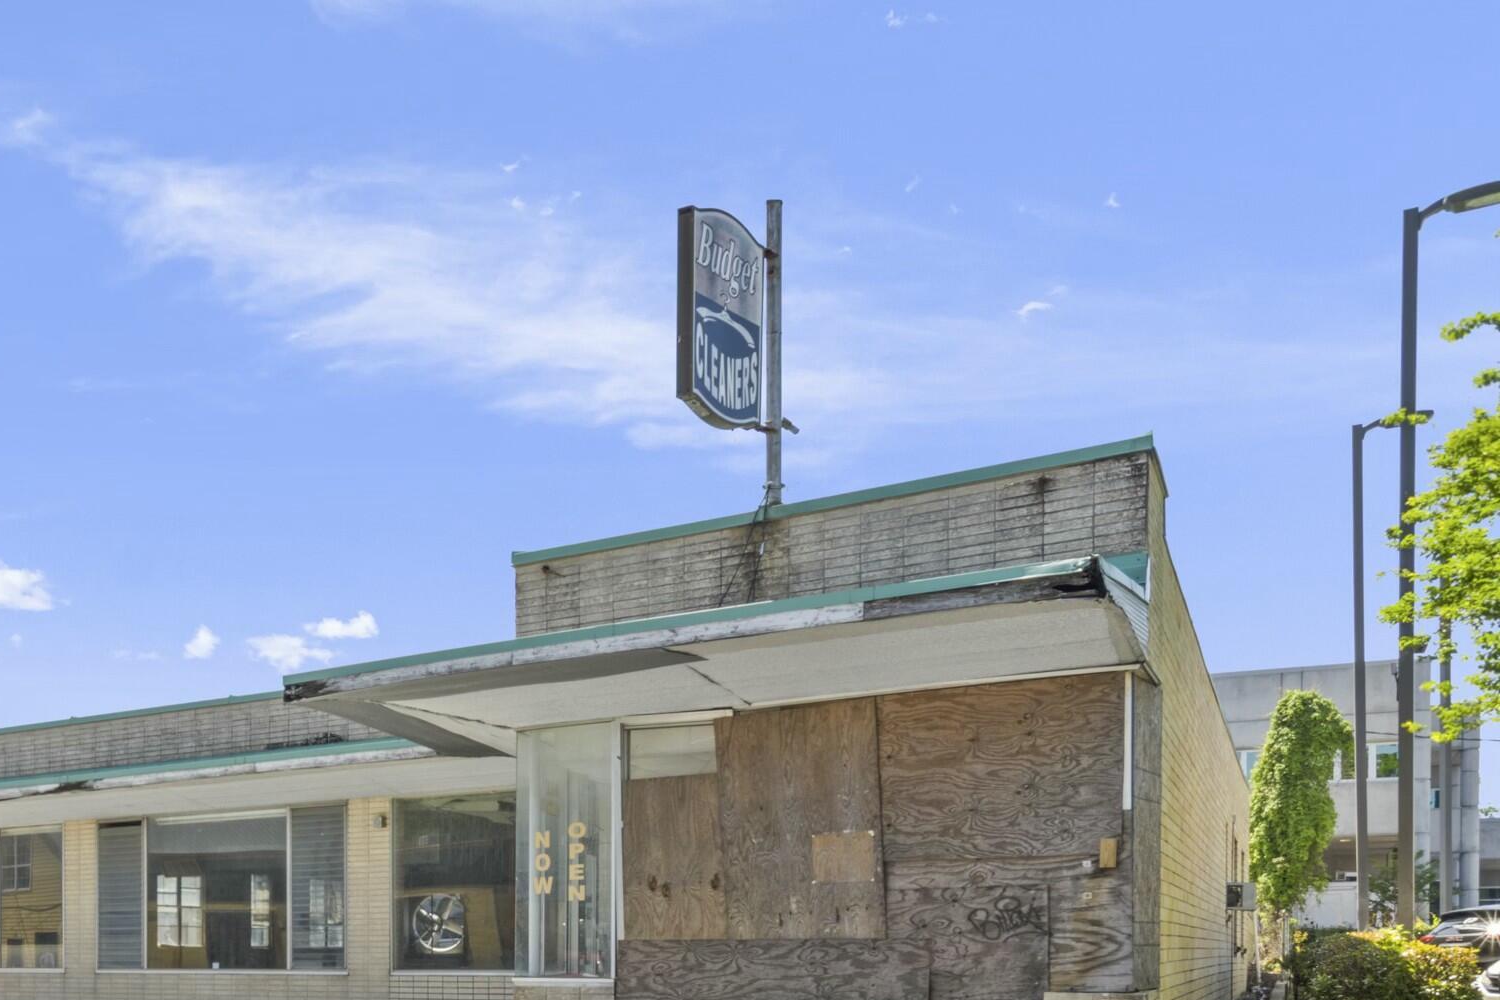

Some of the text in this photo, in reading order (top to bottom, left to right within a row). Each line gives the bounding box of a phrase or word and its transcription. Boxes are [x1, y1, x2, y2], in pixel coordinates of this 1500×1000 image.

[696, 222, 759, 297] Budget
[695, 321, 758, 411] CLEANERS
[533, 830, 553, 895] NOW
[568, 821, 587, 901] OPEN
